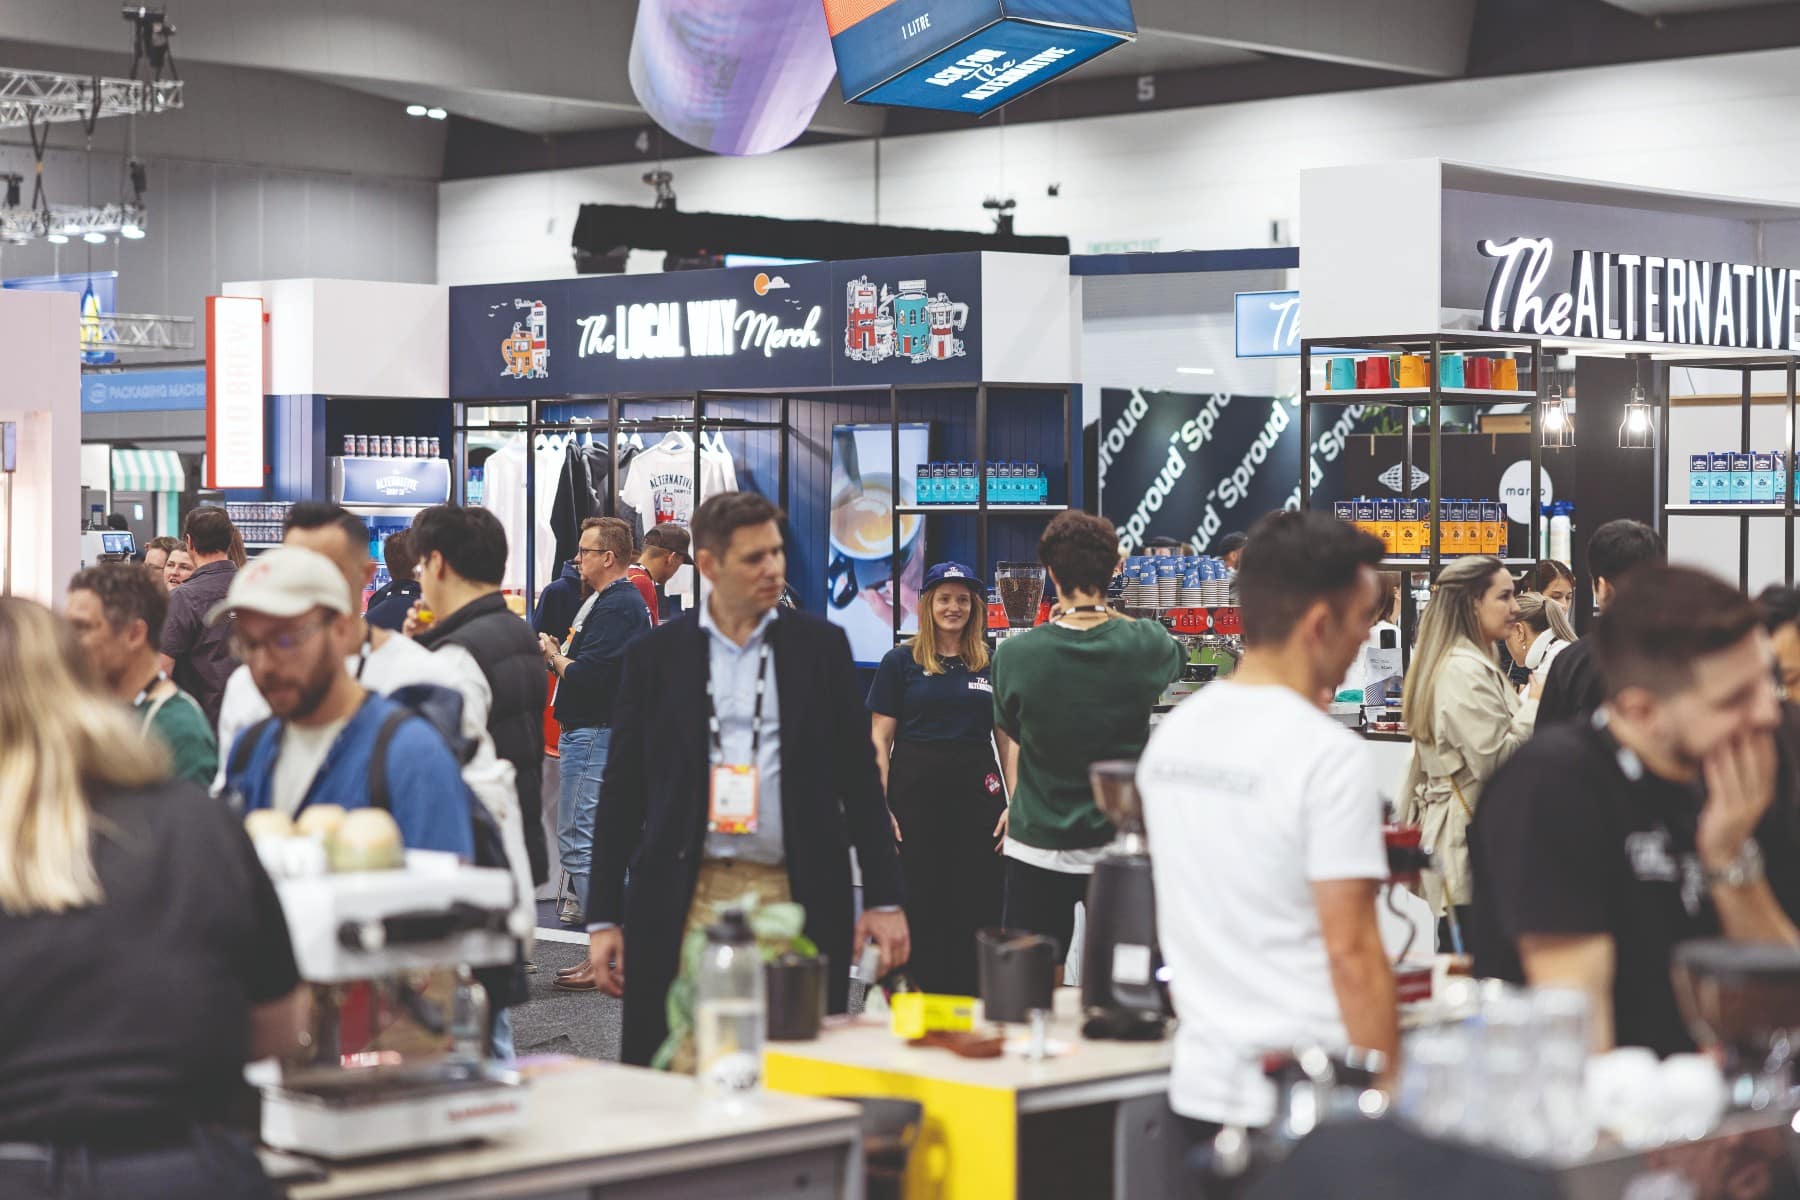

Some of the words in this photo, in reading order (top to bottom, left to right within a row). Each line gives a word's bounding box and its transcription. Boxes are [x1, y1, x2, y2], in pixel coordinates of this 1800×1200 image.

[908, 13, 932, 37] LITRE
[925, 64, 968, 87] ASK
[963, 48, 1007, 69] FOR
[961, 46, 1076, 101] ALTERNATIVE
[963, 58, 1016, 82] The
[1137, 75, 1155, 101] 5
[1481, 236, 1574, 336] The
[576, 314, 615, 358] The
[615, 301, 686, 360] LOCAL
[686, 298, 737, 357] WAY
[734, 304, 822, 358] Merch
[1217, 398, 1291, 509] Sproud
[1505, 486, 1547, 497] maro
